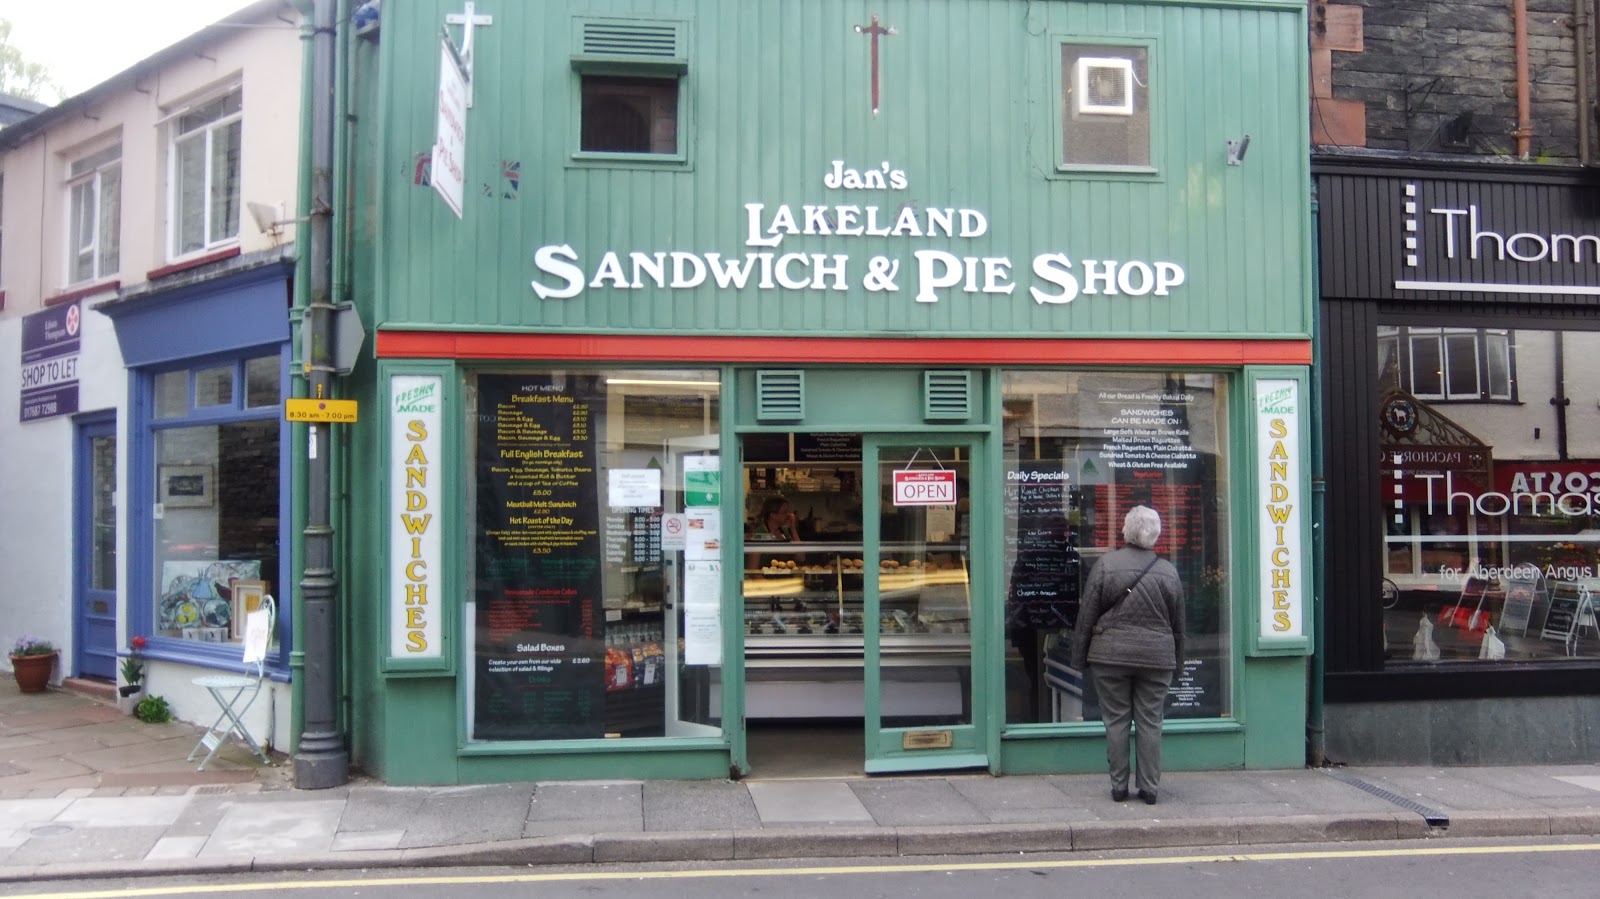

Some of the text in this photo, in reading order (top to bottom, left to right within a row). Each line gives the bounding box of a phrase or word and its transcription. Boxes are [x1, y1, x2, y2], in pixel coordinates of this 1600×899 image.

[824, 160, 908, 190] Jan's
[744, 203, 987, 248] LAKELAND
[1430, 204, 1600, 264] Thom
[531, 244, 1185, 304] SANDWICH & PIE SHOP
[22, 358, 78, 388] SHOP TO LET
[396, 382, 436, 406] FRESHLY
[512, 394, 574, 403] Breakfast Menu
[1260, 386, 1294, 406] FRESHLY
[398, 404, 436, 413] MADE
[1262, 406, 1294, 414] MADE
[500, 450, 583, 459] Full English Breakfast
[1007, 471, 1069, 482] Daily Specials
[904, 485, 946, 498] OPEN
[561, 517, 573, 525] Day
[1266, 418, 1292, 632] SANDWICHES
[401, 420, 432, 653] SANDWICHES
[1439, 564, 1592, 581] for Aberdeen Angus
[517, 643, 565, 652] Salad Boxes
